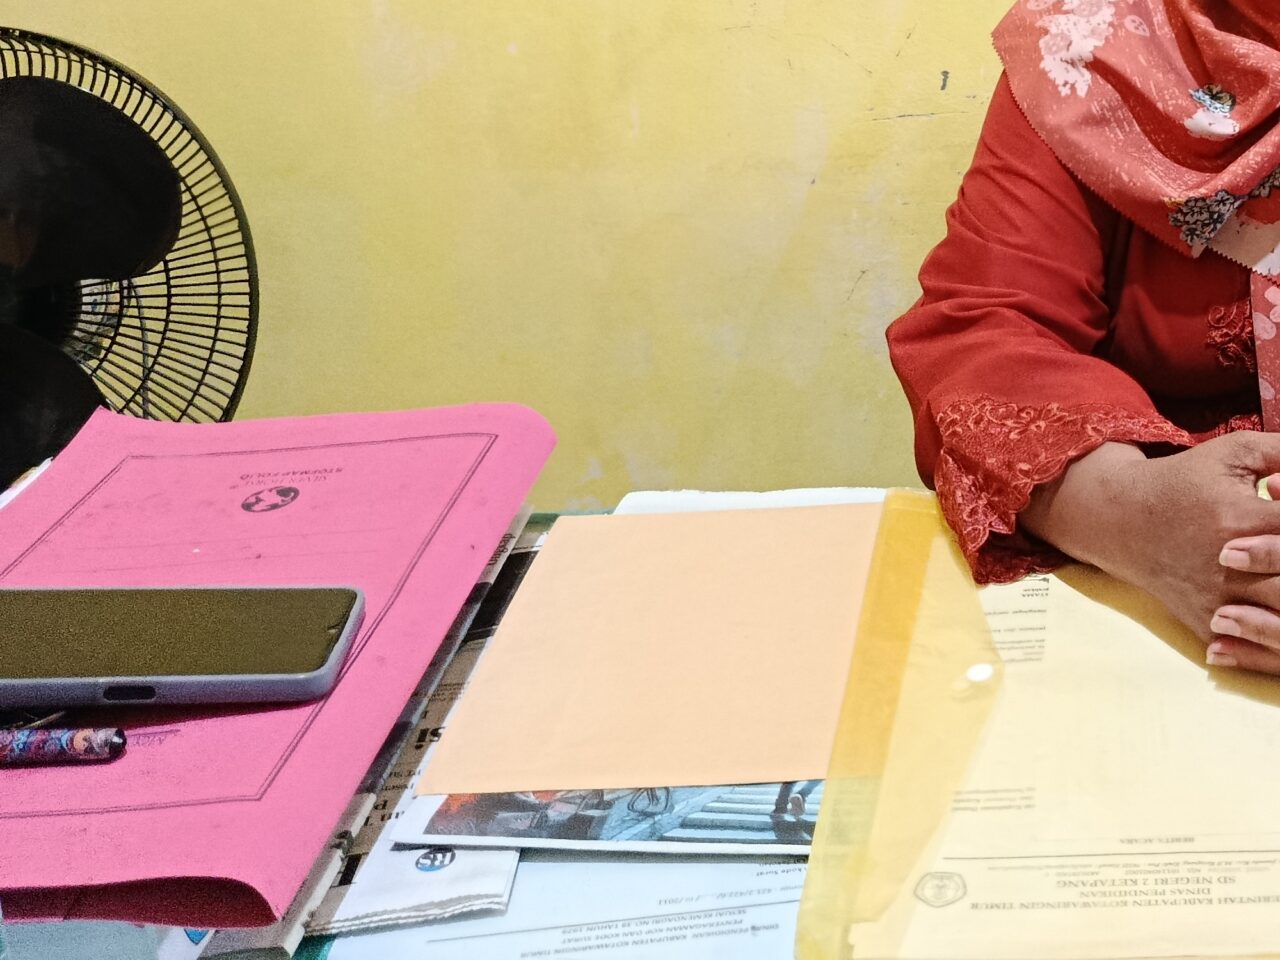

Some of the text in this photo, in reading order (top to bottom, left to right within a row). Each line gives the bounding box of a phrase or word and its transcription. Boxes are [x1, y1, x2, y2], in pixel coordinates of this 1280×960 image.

[1056, 876, 1236, 888] SD NEGERI 2 KETAPANG
[1079, 887, 1210, 898] DINAS PENDIDIKAN
[970, 902, 1015, 910] TIMUR
[1019, 899, 1128, 909] KOTAWARINGIN
[1132, 897, 1213, 907] KABUPATEN
